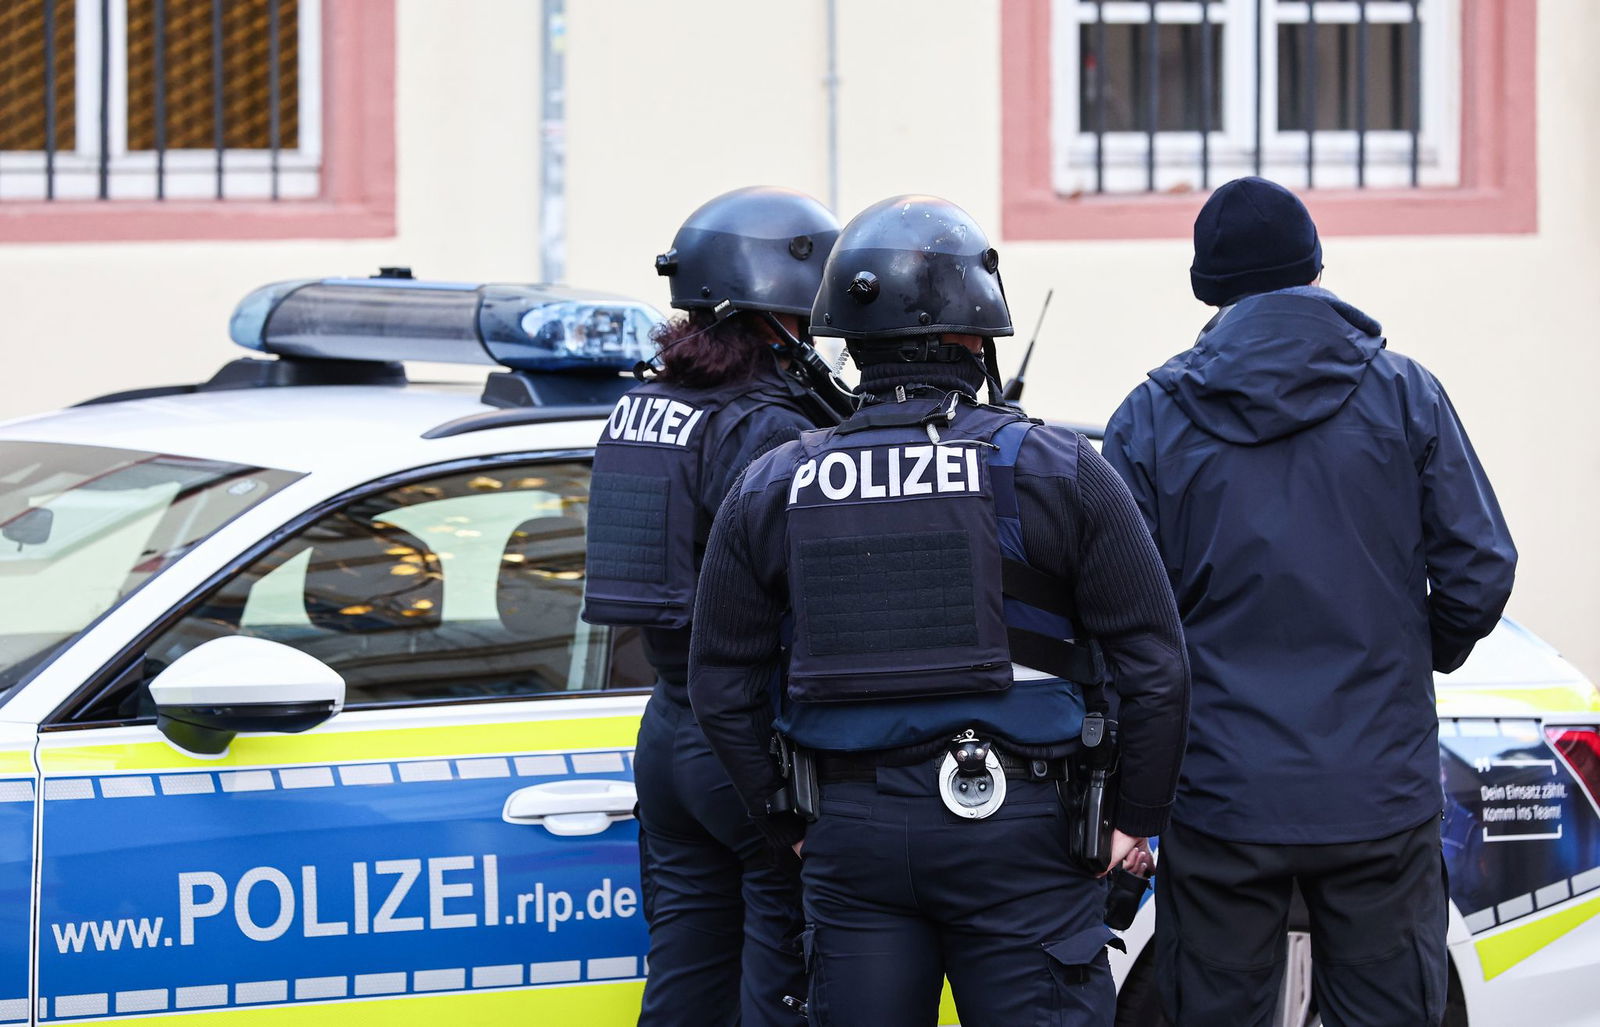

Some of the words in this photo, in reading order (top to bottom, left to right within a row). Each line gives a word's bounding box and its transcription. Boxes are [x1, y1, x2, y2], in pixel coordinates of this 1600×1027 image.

[607, 395, 704, 447] OLIZEI
[788, 445, 980, 504] POLIZEI
[1480, 784, 1505, 801] Dein
[1505, 783, 1541, 800] Einsatz
[1541, 781, 1568, 799] zählt.
[1482, 806, 1516, 822] Komm
[1516, 804, 1532, 821] ins
[1532, 804, 1562, 820] Team!
[52, 854, 638, 954] www.POLIZEI.rlp.de
